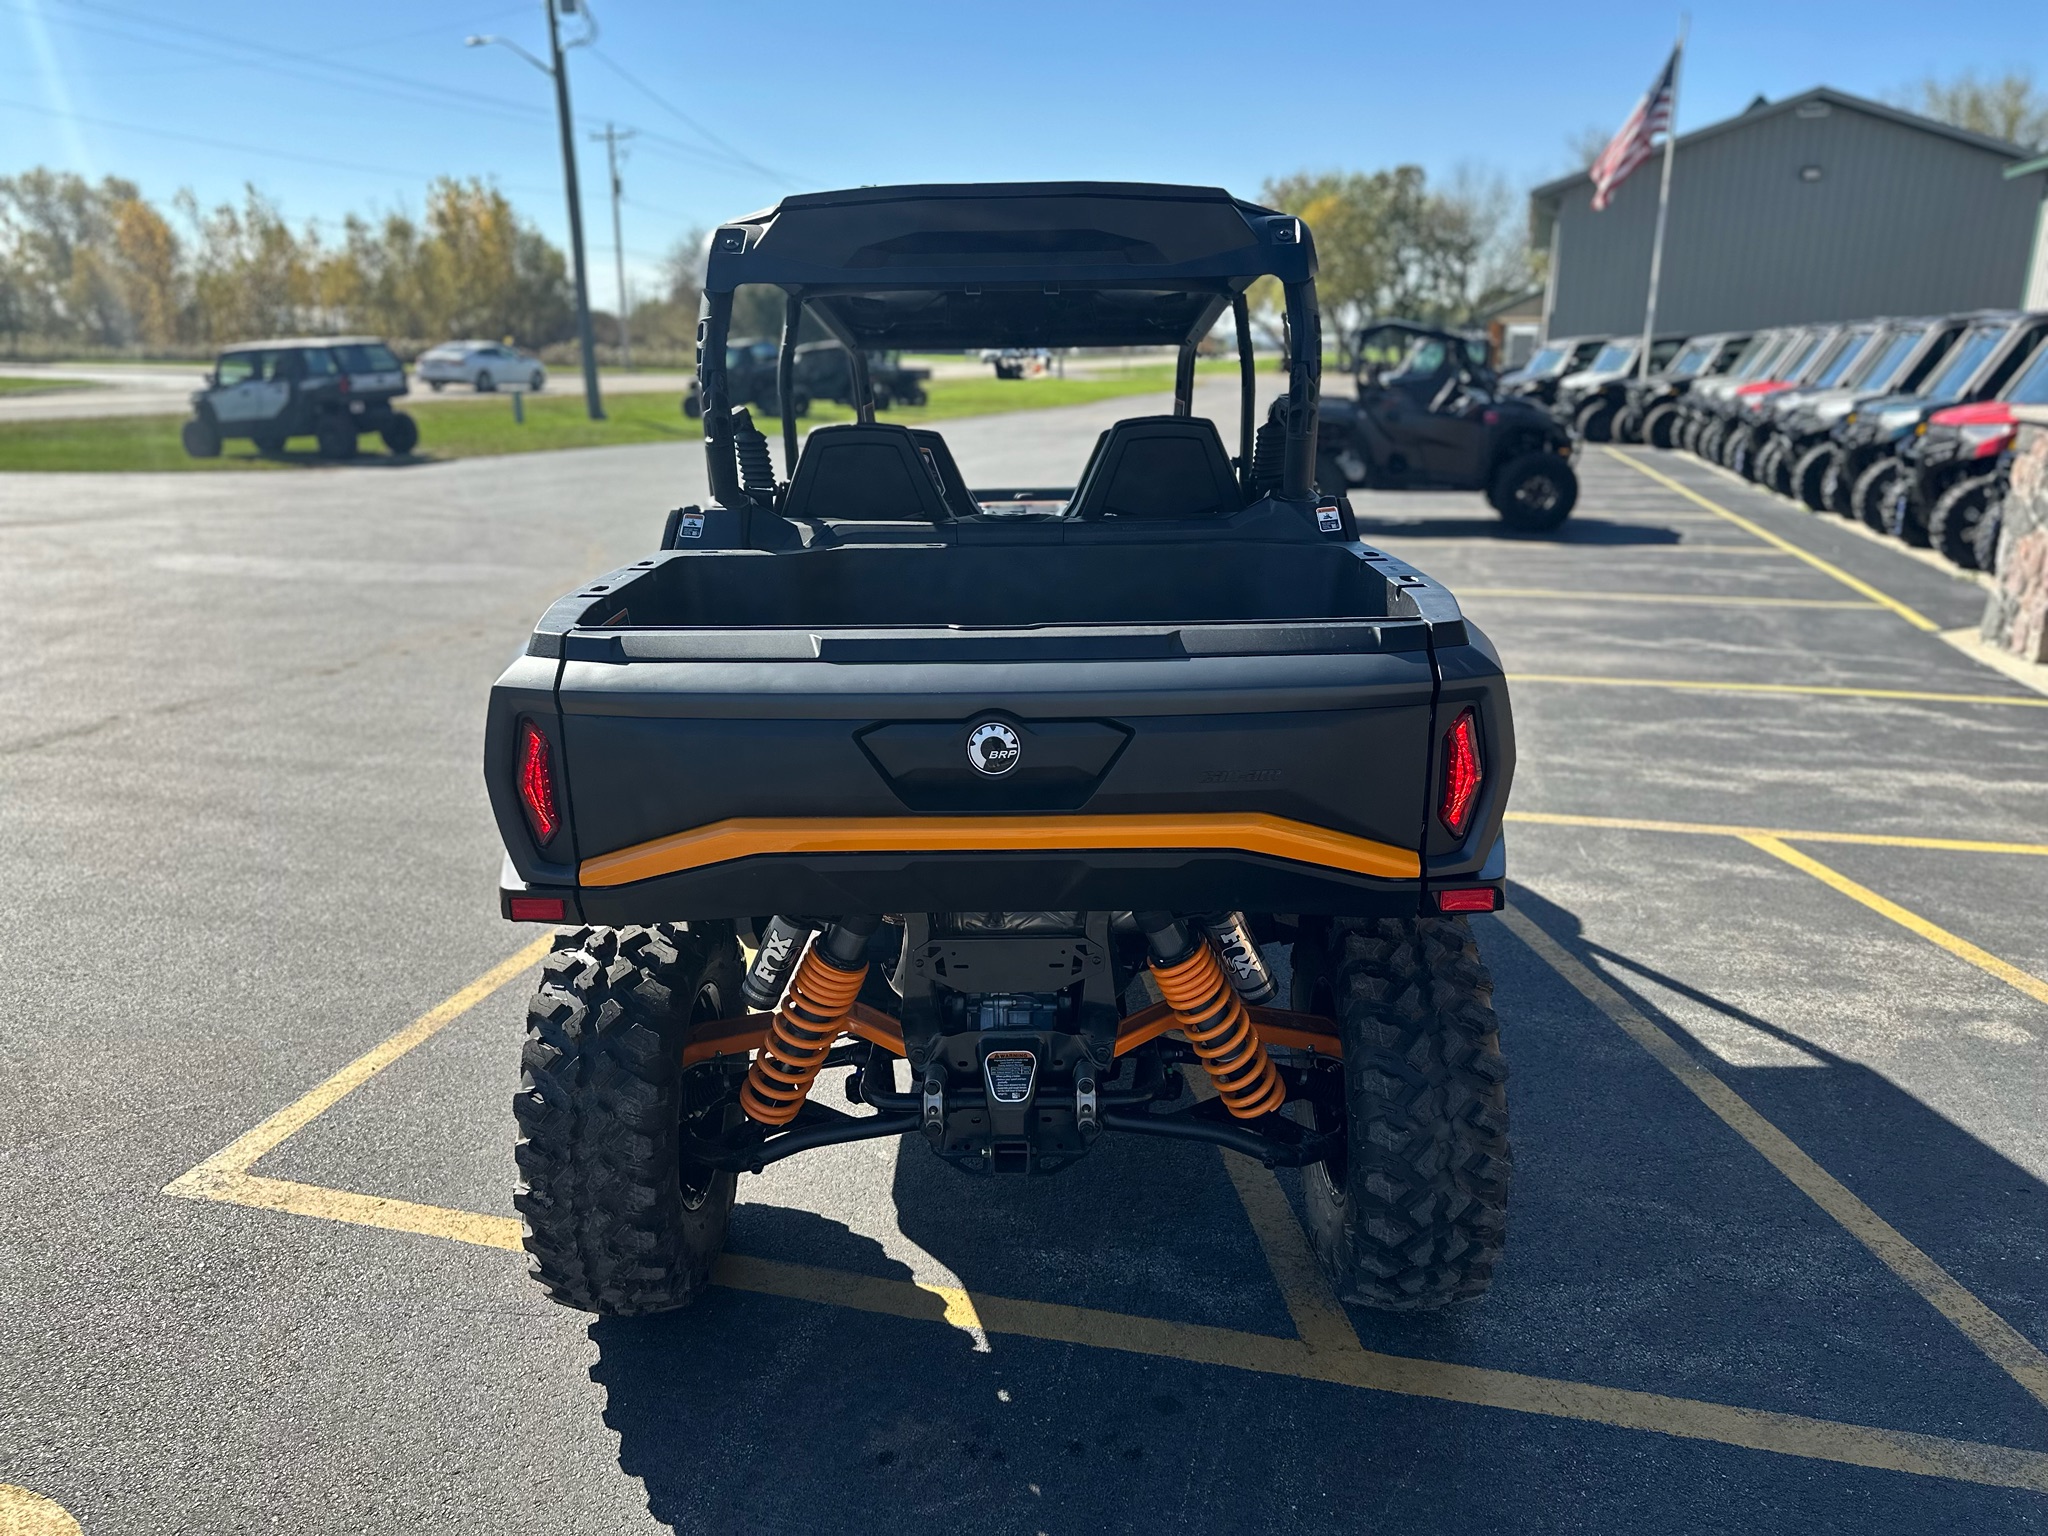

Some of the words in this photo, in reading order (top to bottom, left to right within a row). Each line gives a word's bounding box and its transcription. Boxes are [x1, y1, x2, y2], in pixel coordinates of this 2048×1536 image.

[989, 750, 1017, 759] BRP
[755, 928, 796, 984] FOX
[1220, 925, 1261, 980] FOX
